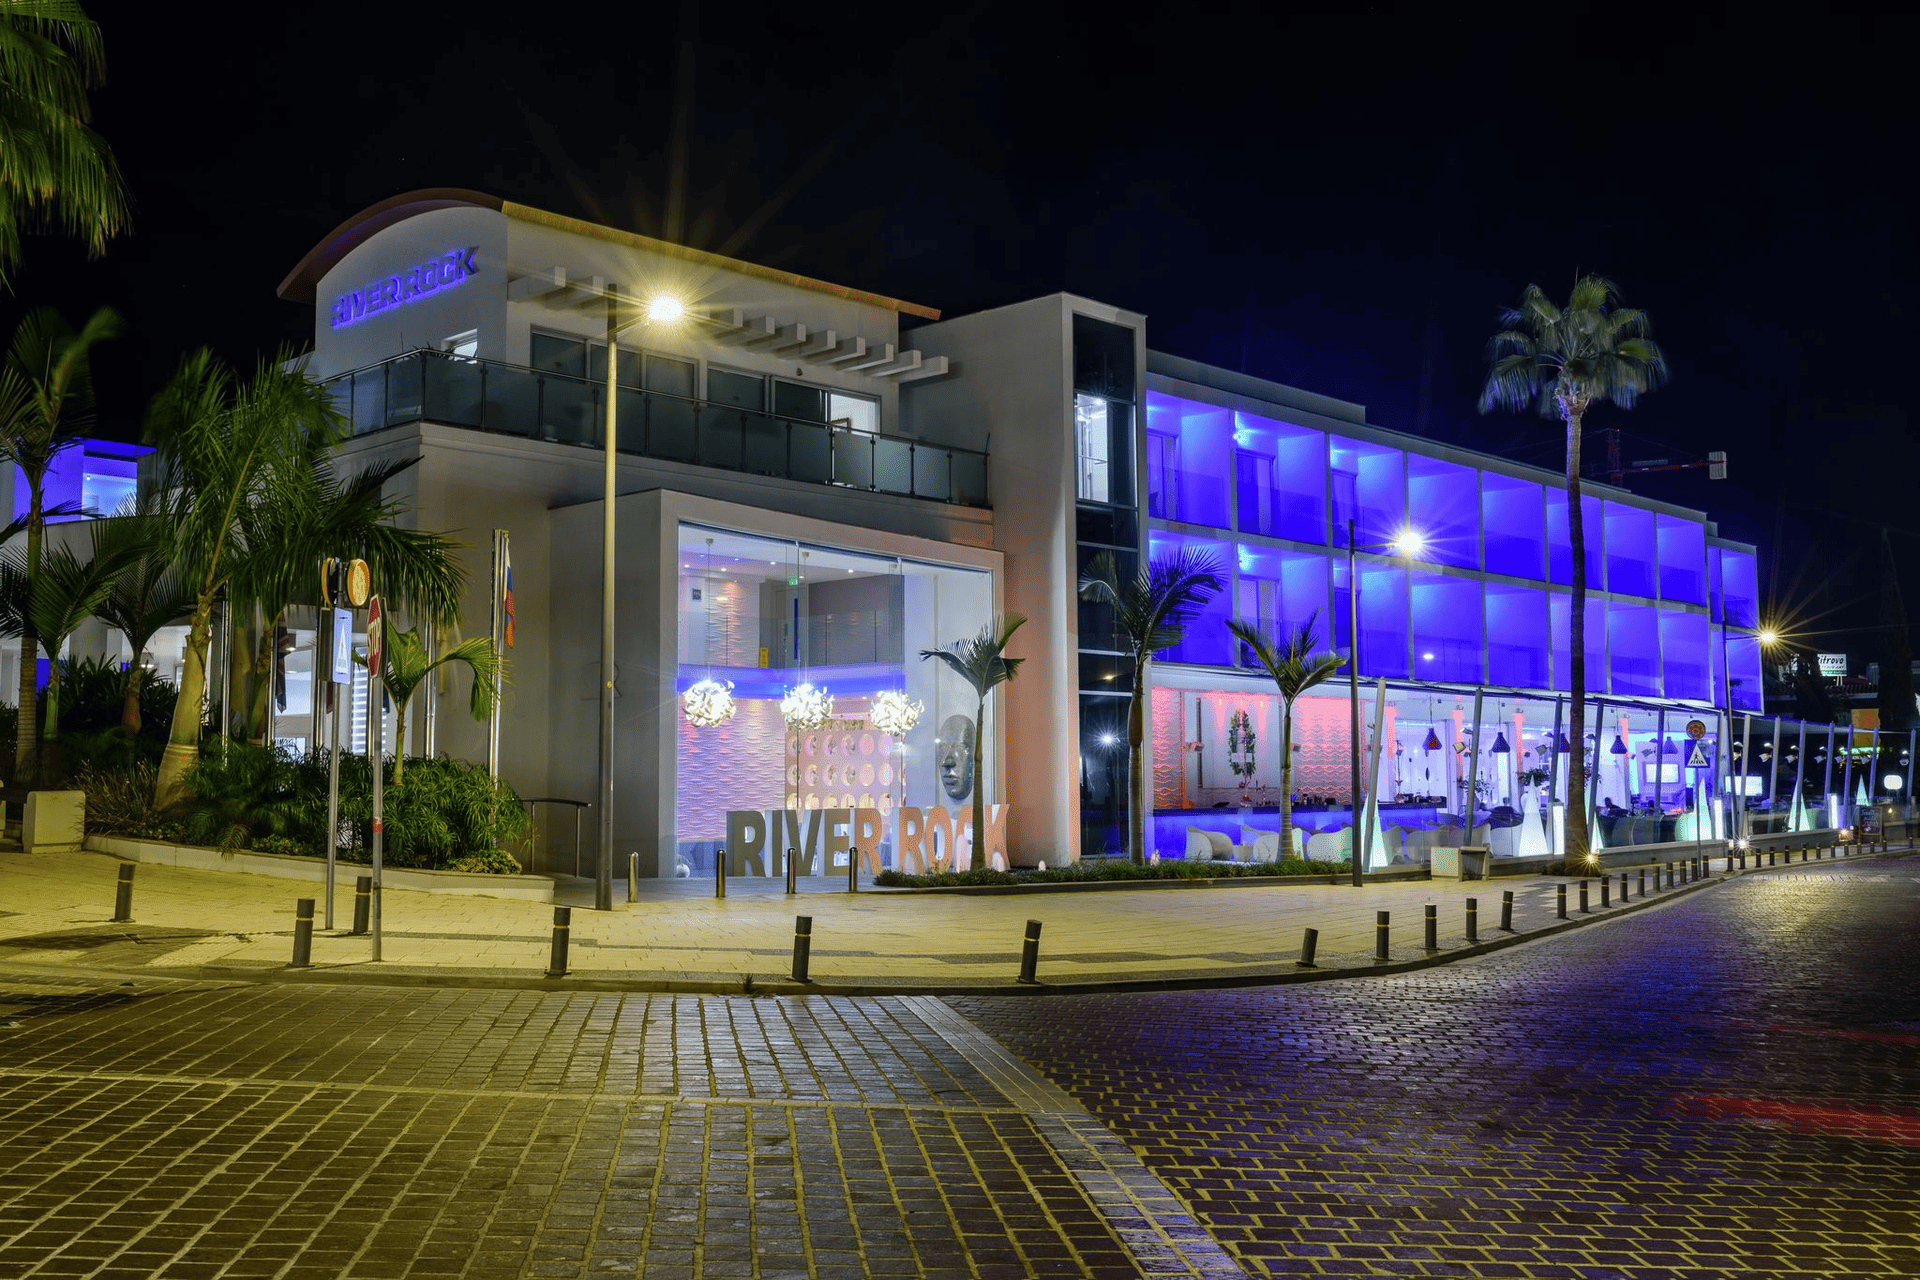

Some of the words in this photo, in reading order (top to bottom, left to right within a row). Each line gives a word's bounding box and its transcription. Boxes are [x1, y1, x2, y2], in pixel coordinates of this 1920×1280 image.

[331, 275, 401, 329] RIVER
[402, 246, 480, 302] ROCK
[1817, 655, 1844, 665] itrovo
[727, 809, 882, 877] RIVER
